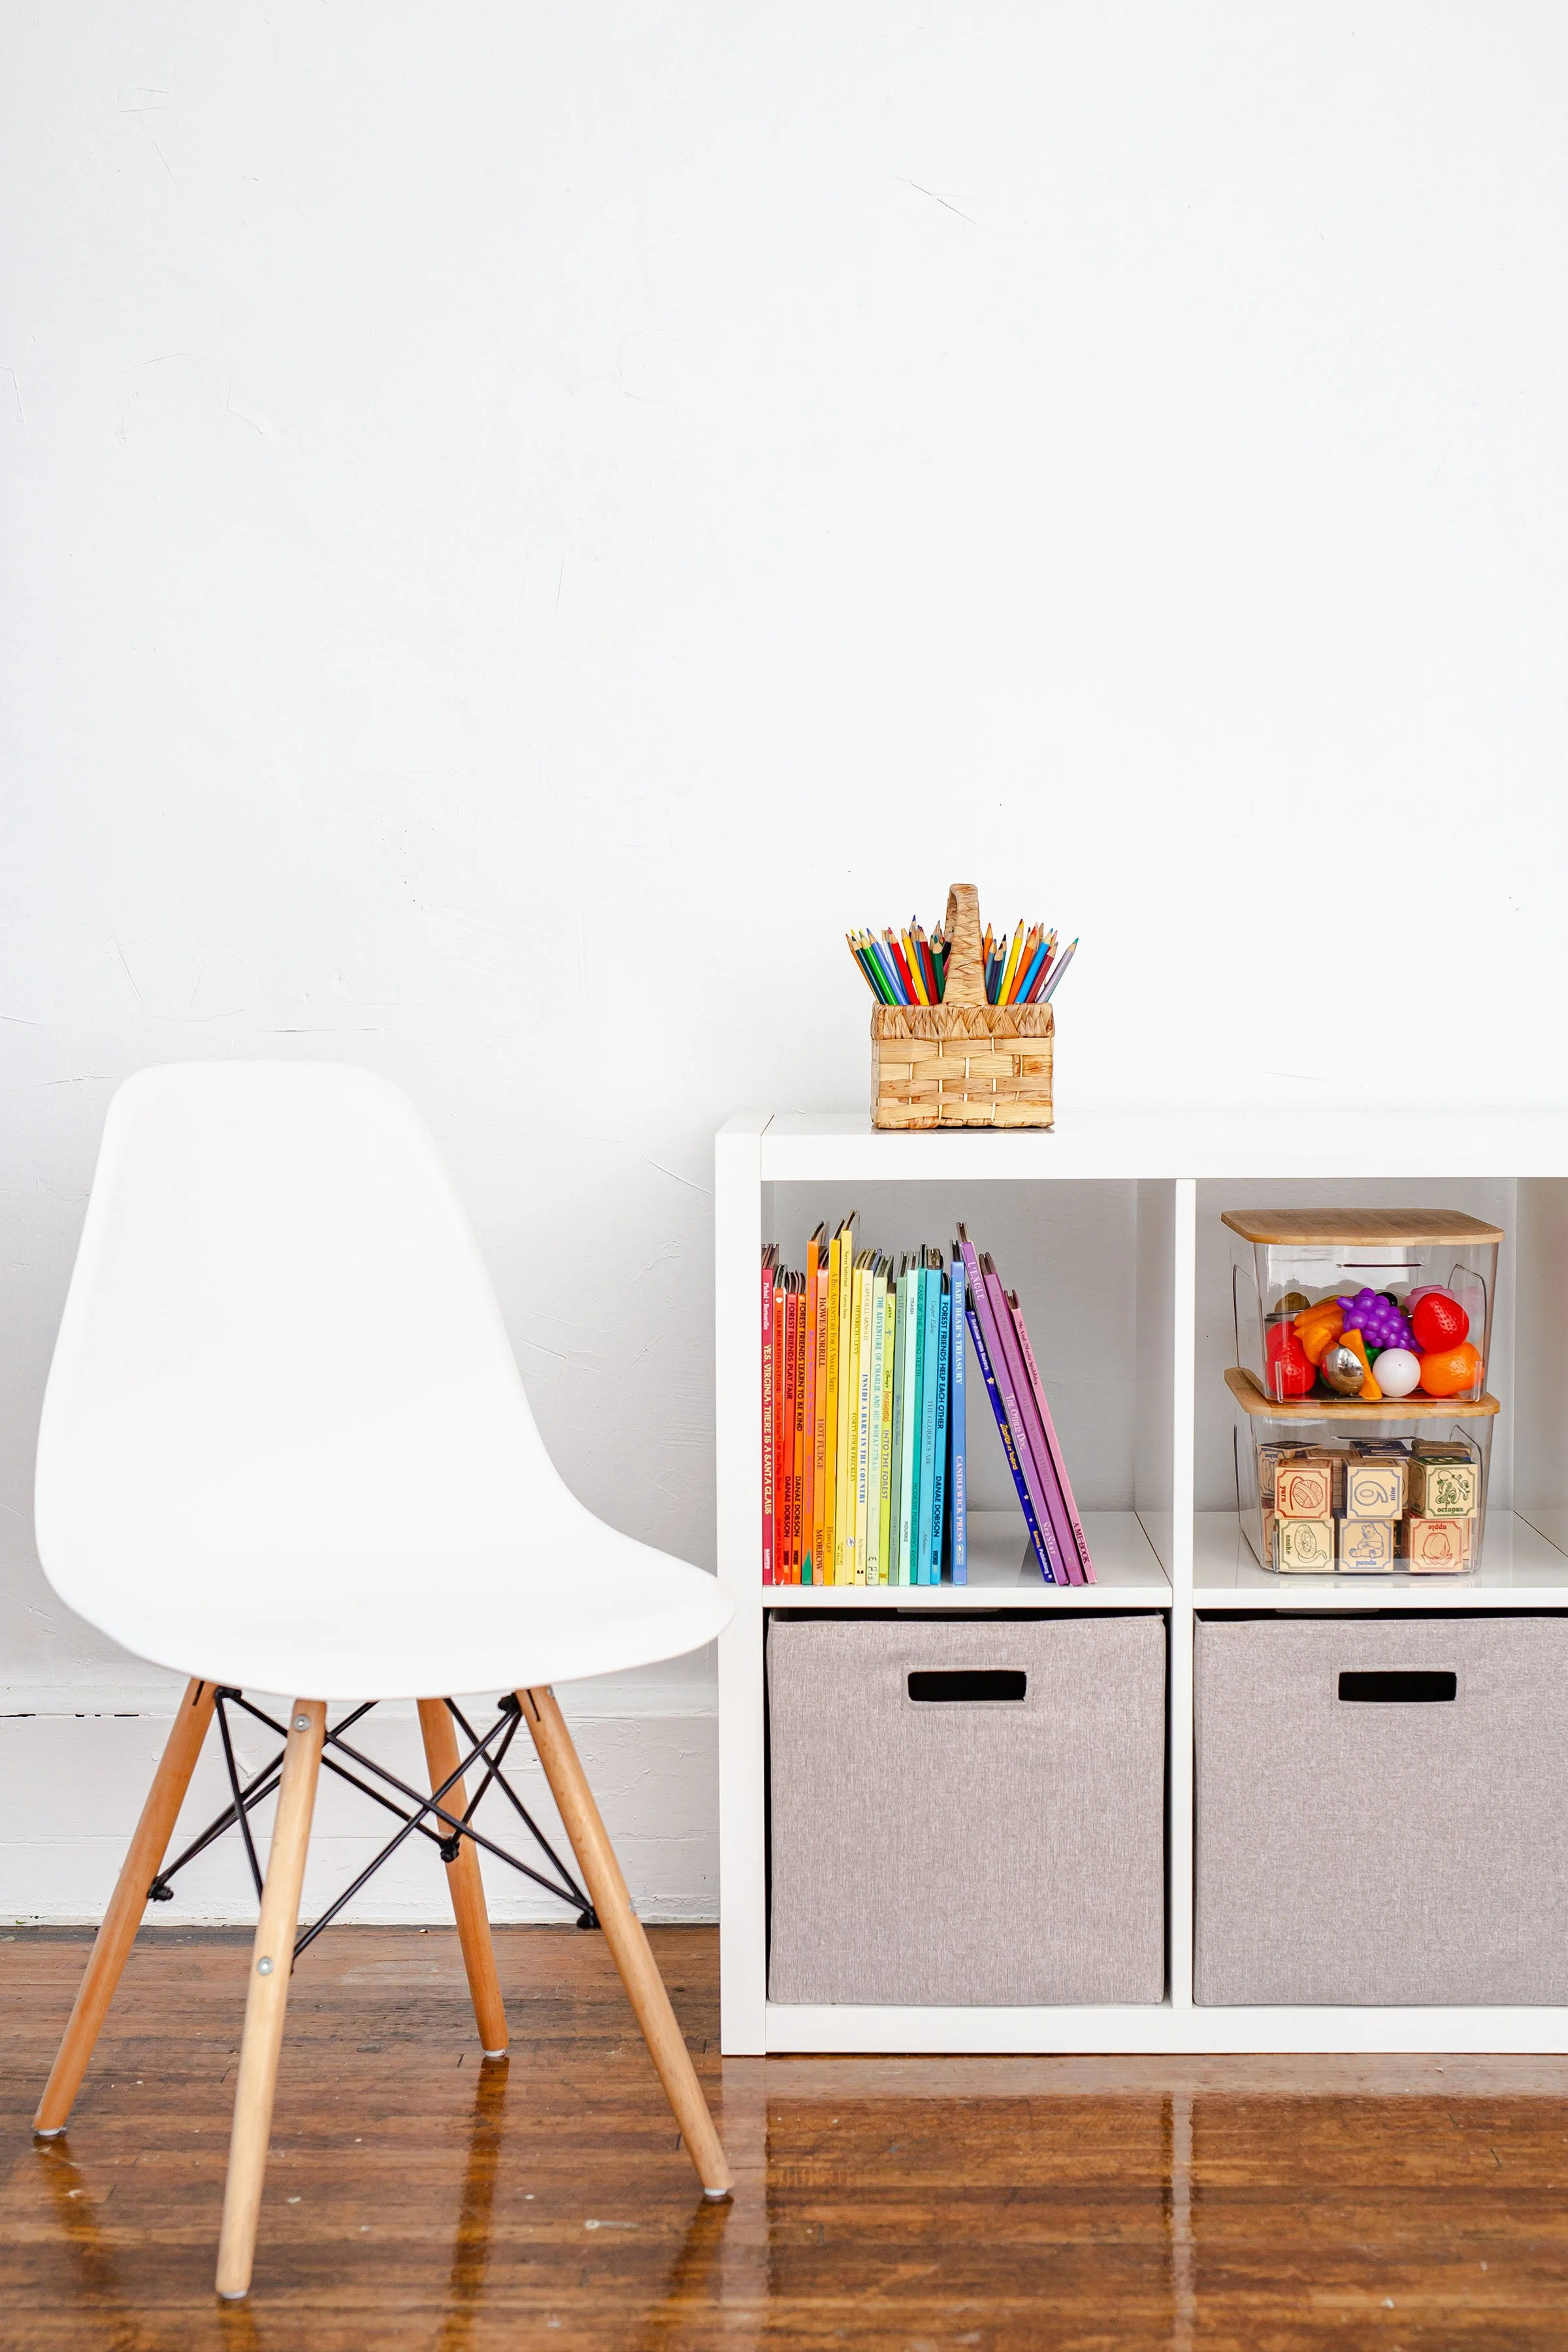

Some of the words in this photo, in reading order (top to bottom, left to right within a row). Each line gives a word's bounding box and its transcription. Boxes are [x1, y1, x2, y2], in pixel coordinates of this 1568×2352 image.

[968, 1262, 985, 1301] L'ENGLE
[917, 1303, 923, 1314] OF
[971, 1318, 980, 1340] Bedtime
[1019, 1320, 1024, 1330] Me
[1029, 1361, 1038, 1385] Stubbles
[797, 1401, 804, 1410] BE
[798, 1390, 804, 1399] TO
[883, 1390, 892, 1422] POCAHONTAS
[860, 1437, 866, 1447] IN
[1009, 1450, 1018, 1470] Toyland
[1030, 1423, 1042, 1456] PRINCESS
[1039, 1458, 1051, 1487] STORIES
[1075, 1529, 1090, 1564] ME-BOOK
[1039, 1548, 1049, 1574] Publishing
